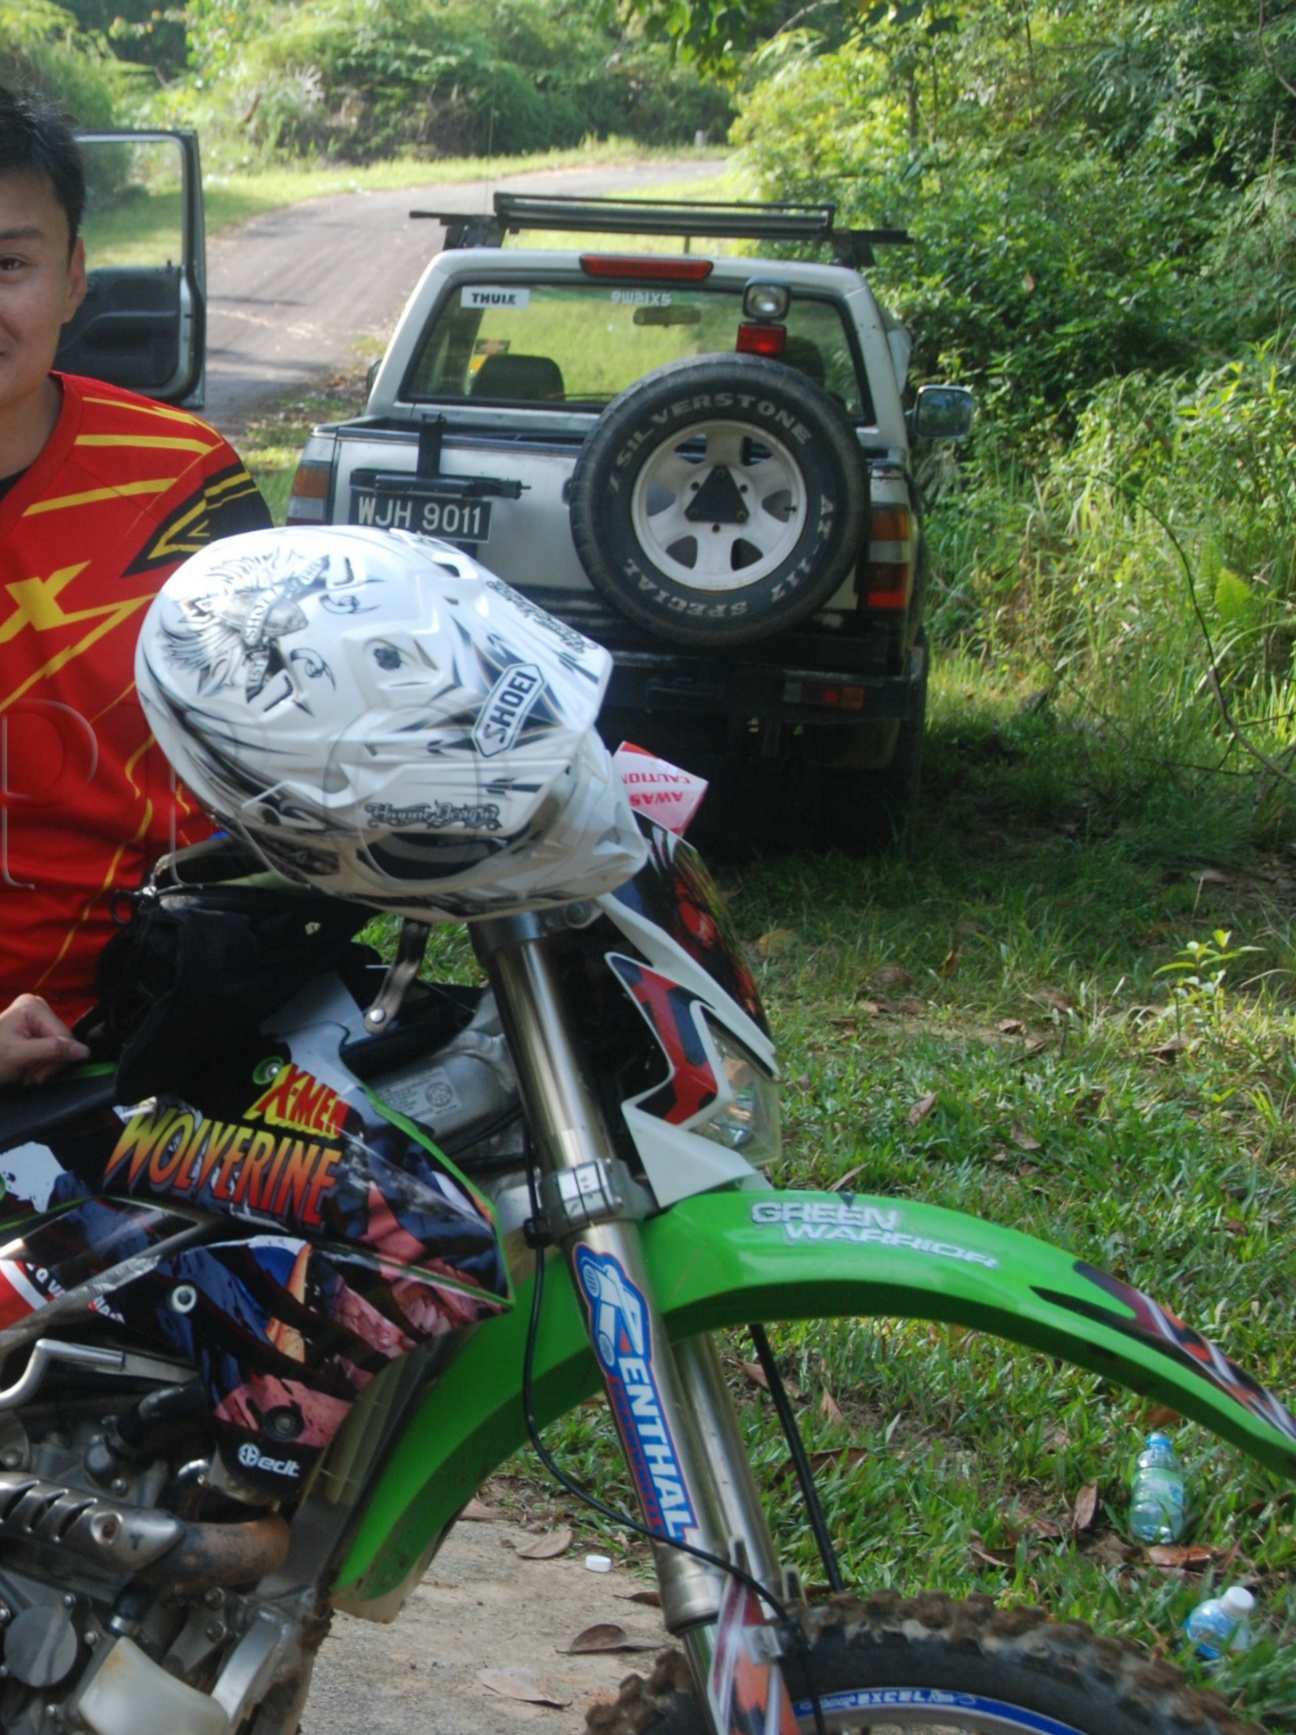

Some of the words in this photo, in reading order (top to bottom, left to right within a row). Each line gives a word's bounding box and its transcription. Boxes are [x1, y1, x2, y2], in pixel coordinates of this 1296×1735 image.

[471, 293, 516, 304] THULE
[616, 392, 813, 470] SILVERSTONE
[358, 496, 412, 528] WJH
[422, 502, 481, 535] 9011
[624, 558, 747, 618] SPECIAL
[480, 671, 537, 743] SHOEI
[630, 791, 683, 806] AWAS
[105, 1105, 342, 1227] WOLVERINE
[750, 1202, 897, 1228] GREEN
[785, 1221, 998, 1268] WARRIOR
[581, 1258, 698, 1543] RENTHAL
[857, 1690, 926, 1705] EXCEL
